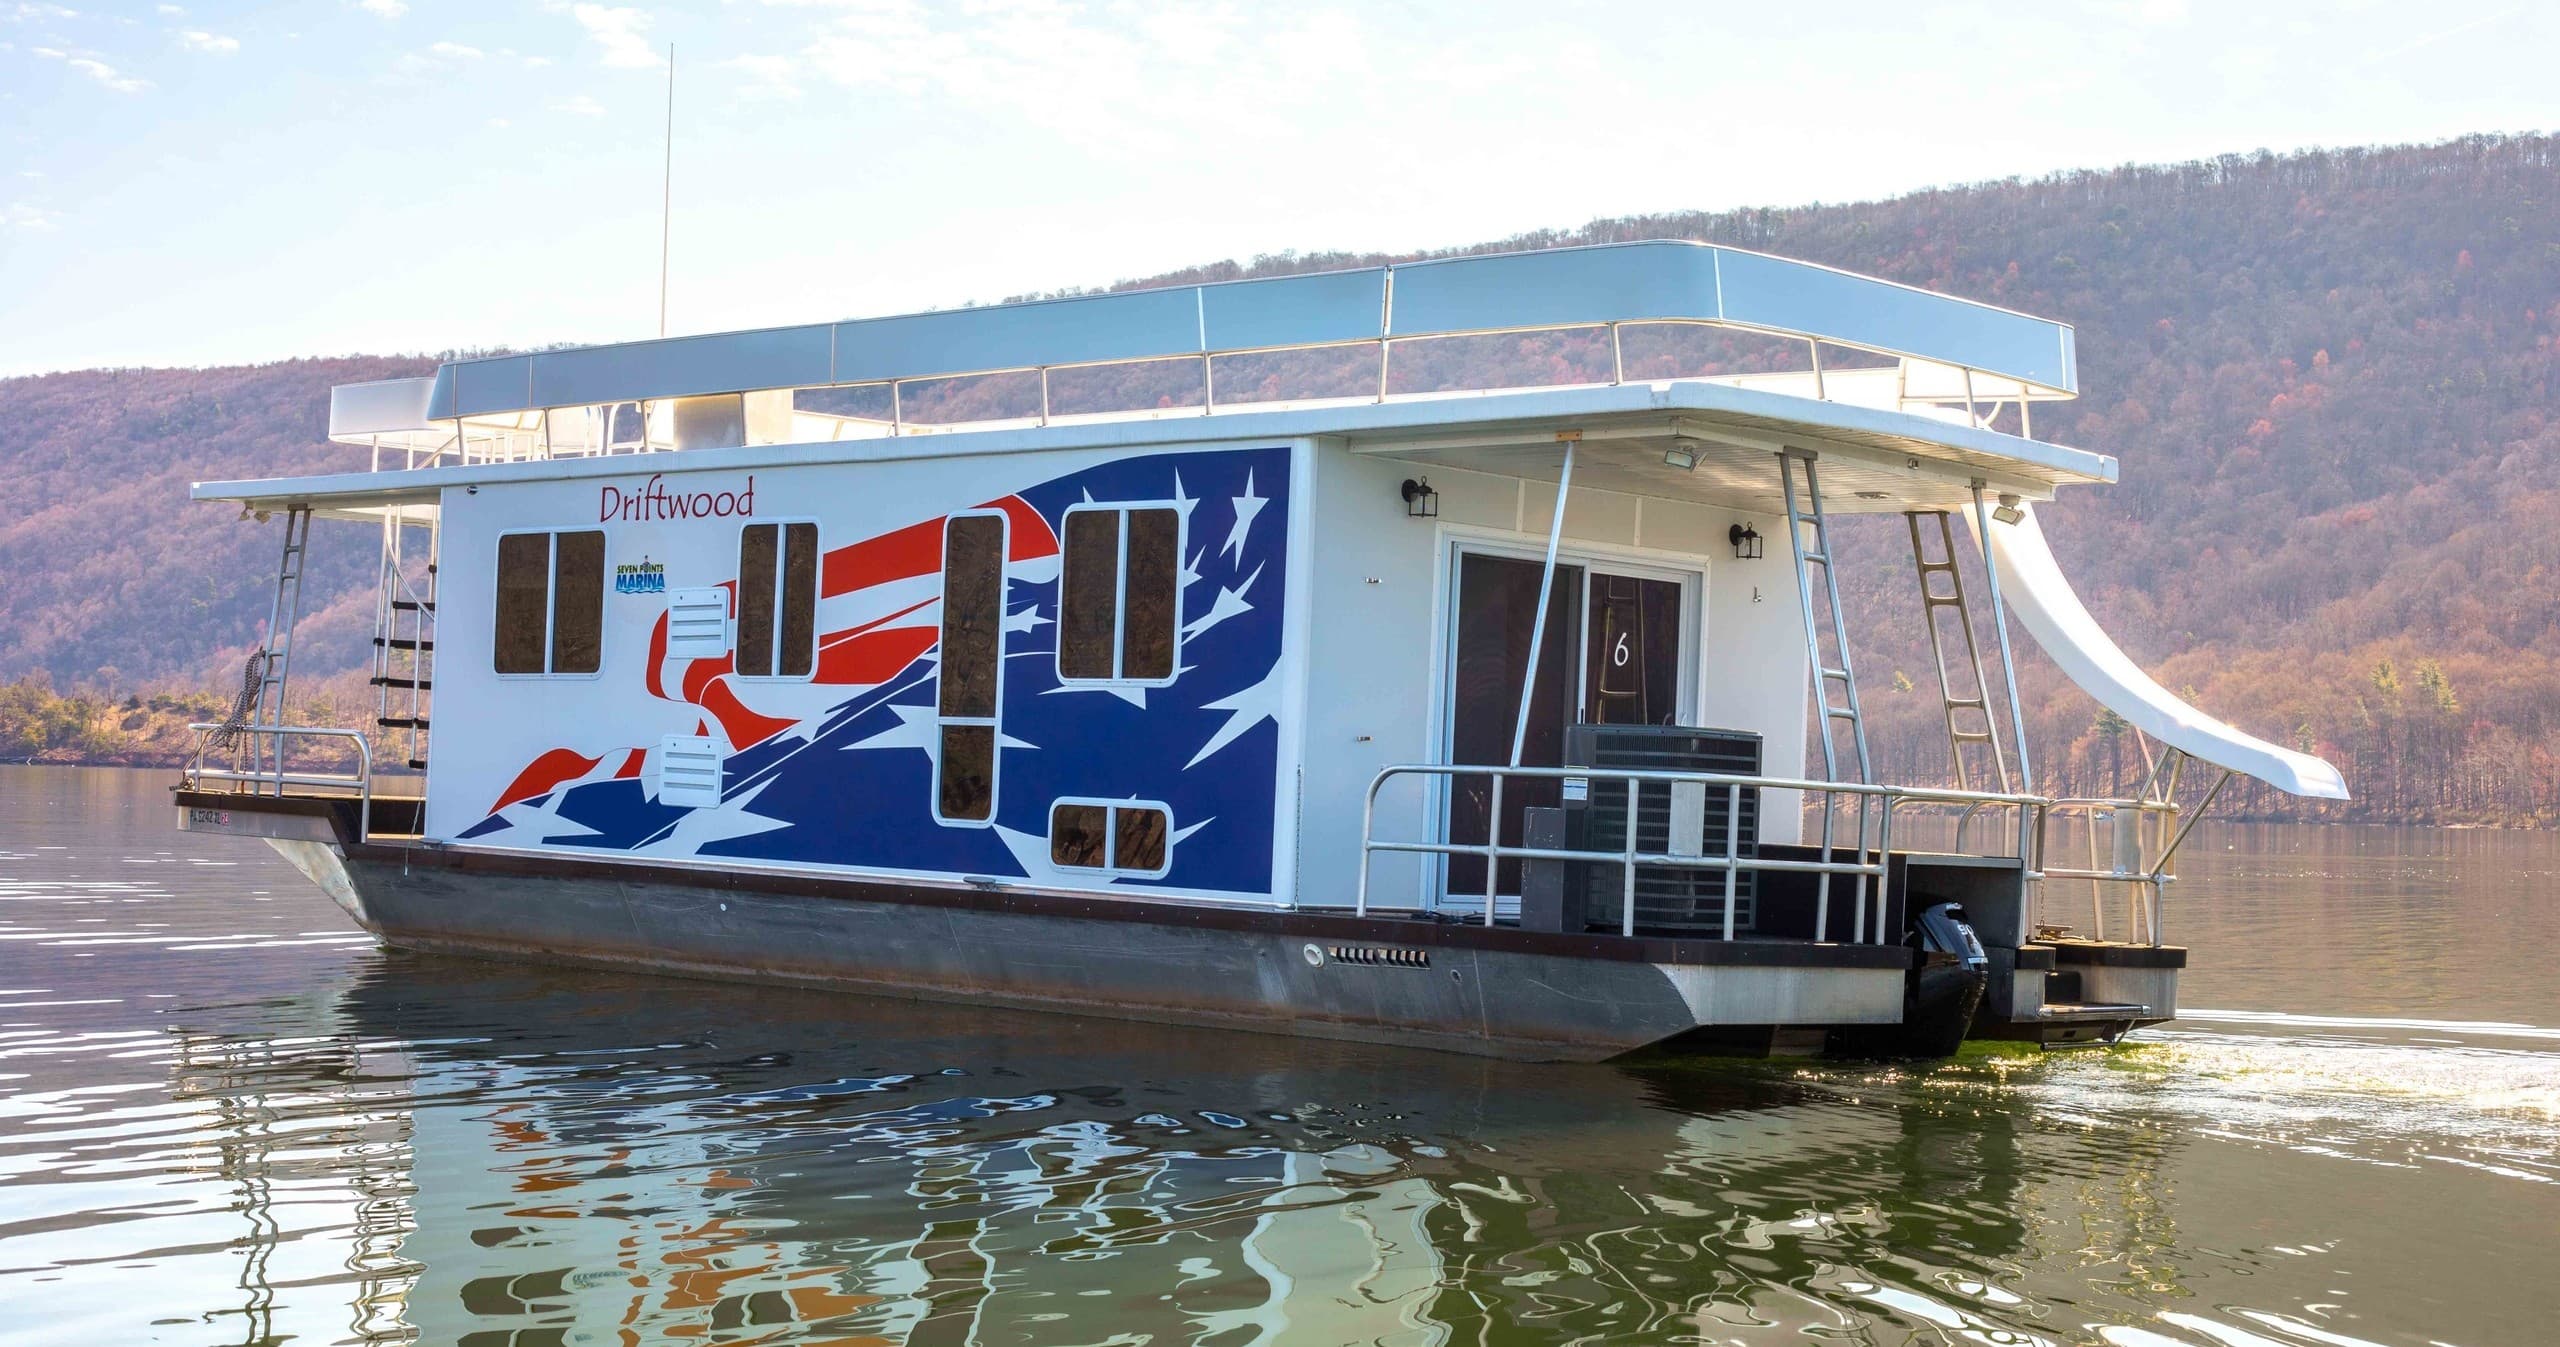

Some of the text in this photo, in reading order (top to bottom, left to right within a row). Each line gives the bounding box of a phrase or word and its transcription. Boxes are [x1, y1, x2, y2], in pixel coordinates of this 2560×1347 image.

[600, 473, 754, 523] Driftwood
[616, 573, 665, 590] MARINA
[617, 564, 664, 574] SEVEN POINTS
[1614, 632, 1629, 667] 6
